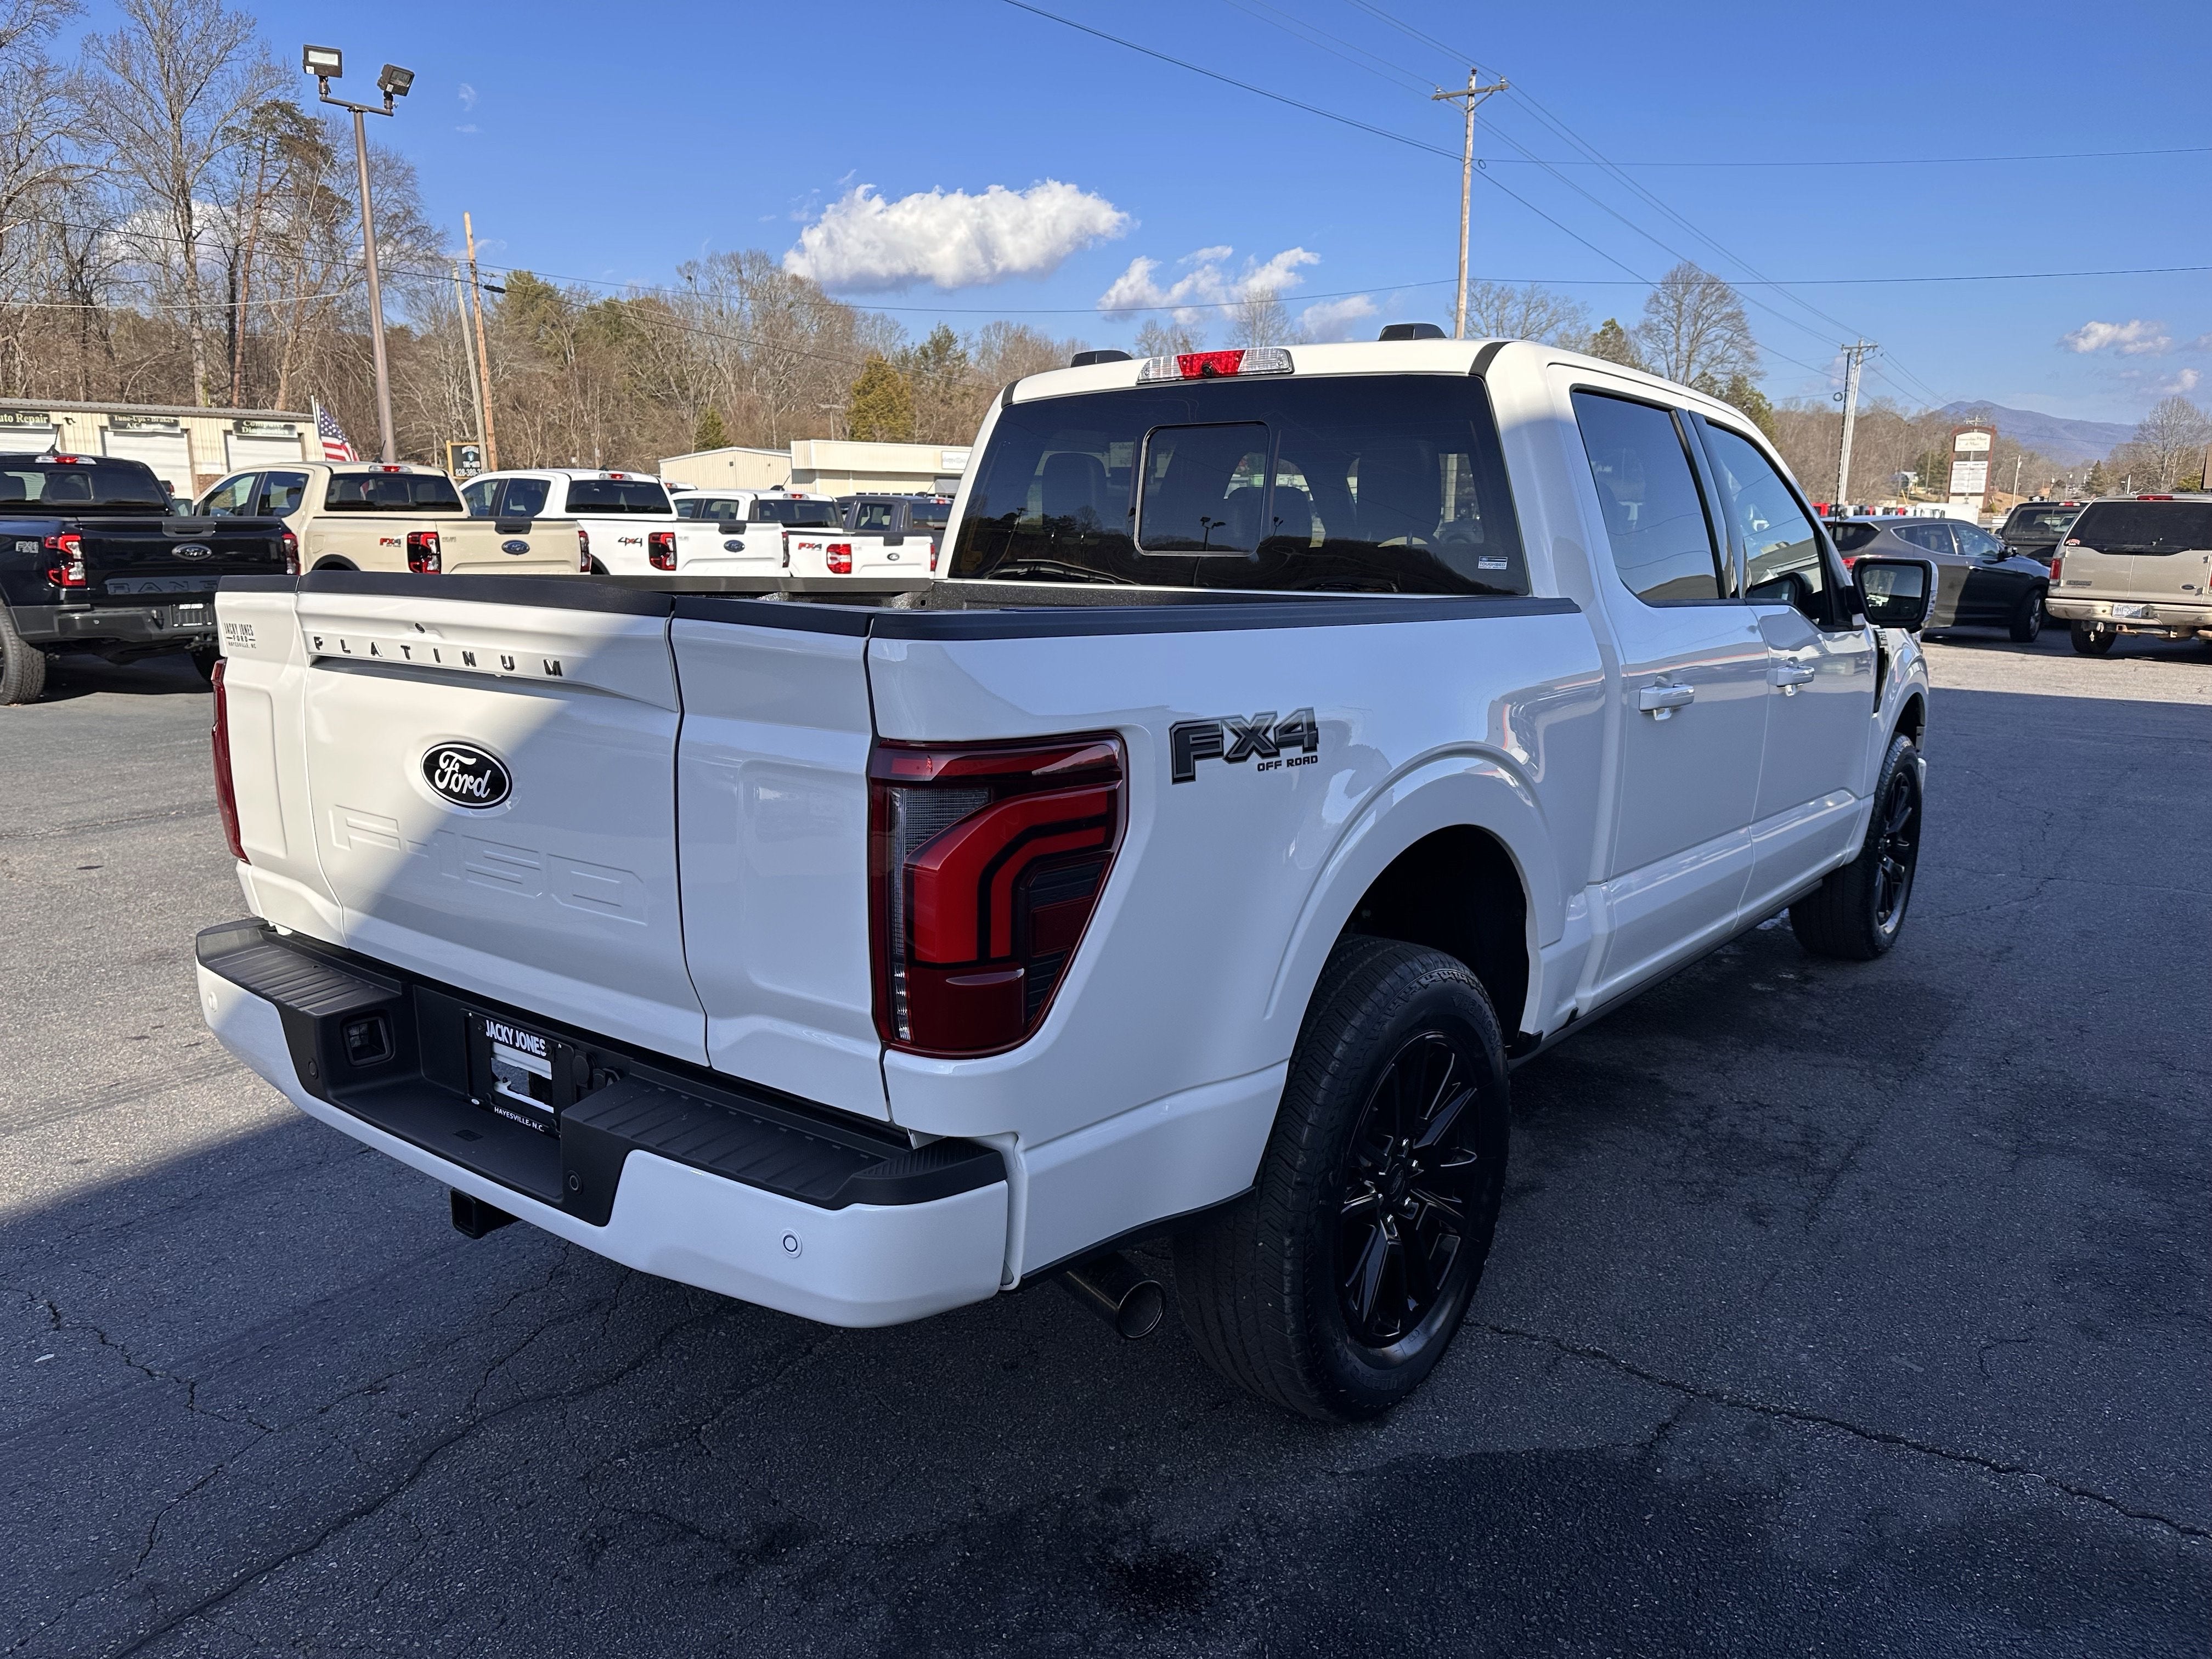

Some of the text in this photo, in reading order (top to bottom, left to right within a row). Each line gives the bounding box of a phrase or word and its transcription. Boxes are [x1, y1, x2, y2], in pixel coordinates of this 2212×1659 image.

[0, 413, 48, 425] uto Repair
[109, 580, 218, 594] RANG
[224, 623, 254, 636] JACKY JONES
[313, 636, 563, 677] PLATINUM
[1168, 706, 1319, 785] FX4
[435, 751, 492, 798] Ford
[1257, 755, 1318, 772] OFF ROAD
[328, 804, 649, 927] F-150
[486, 1019, 547, 1057] JACKY JONES
[532, 1121, 545, 1132] N.C.
